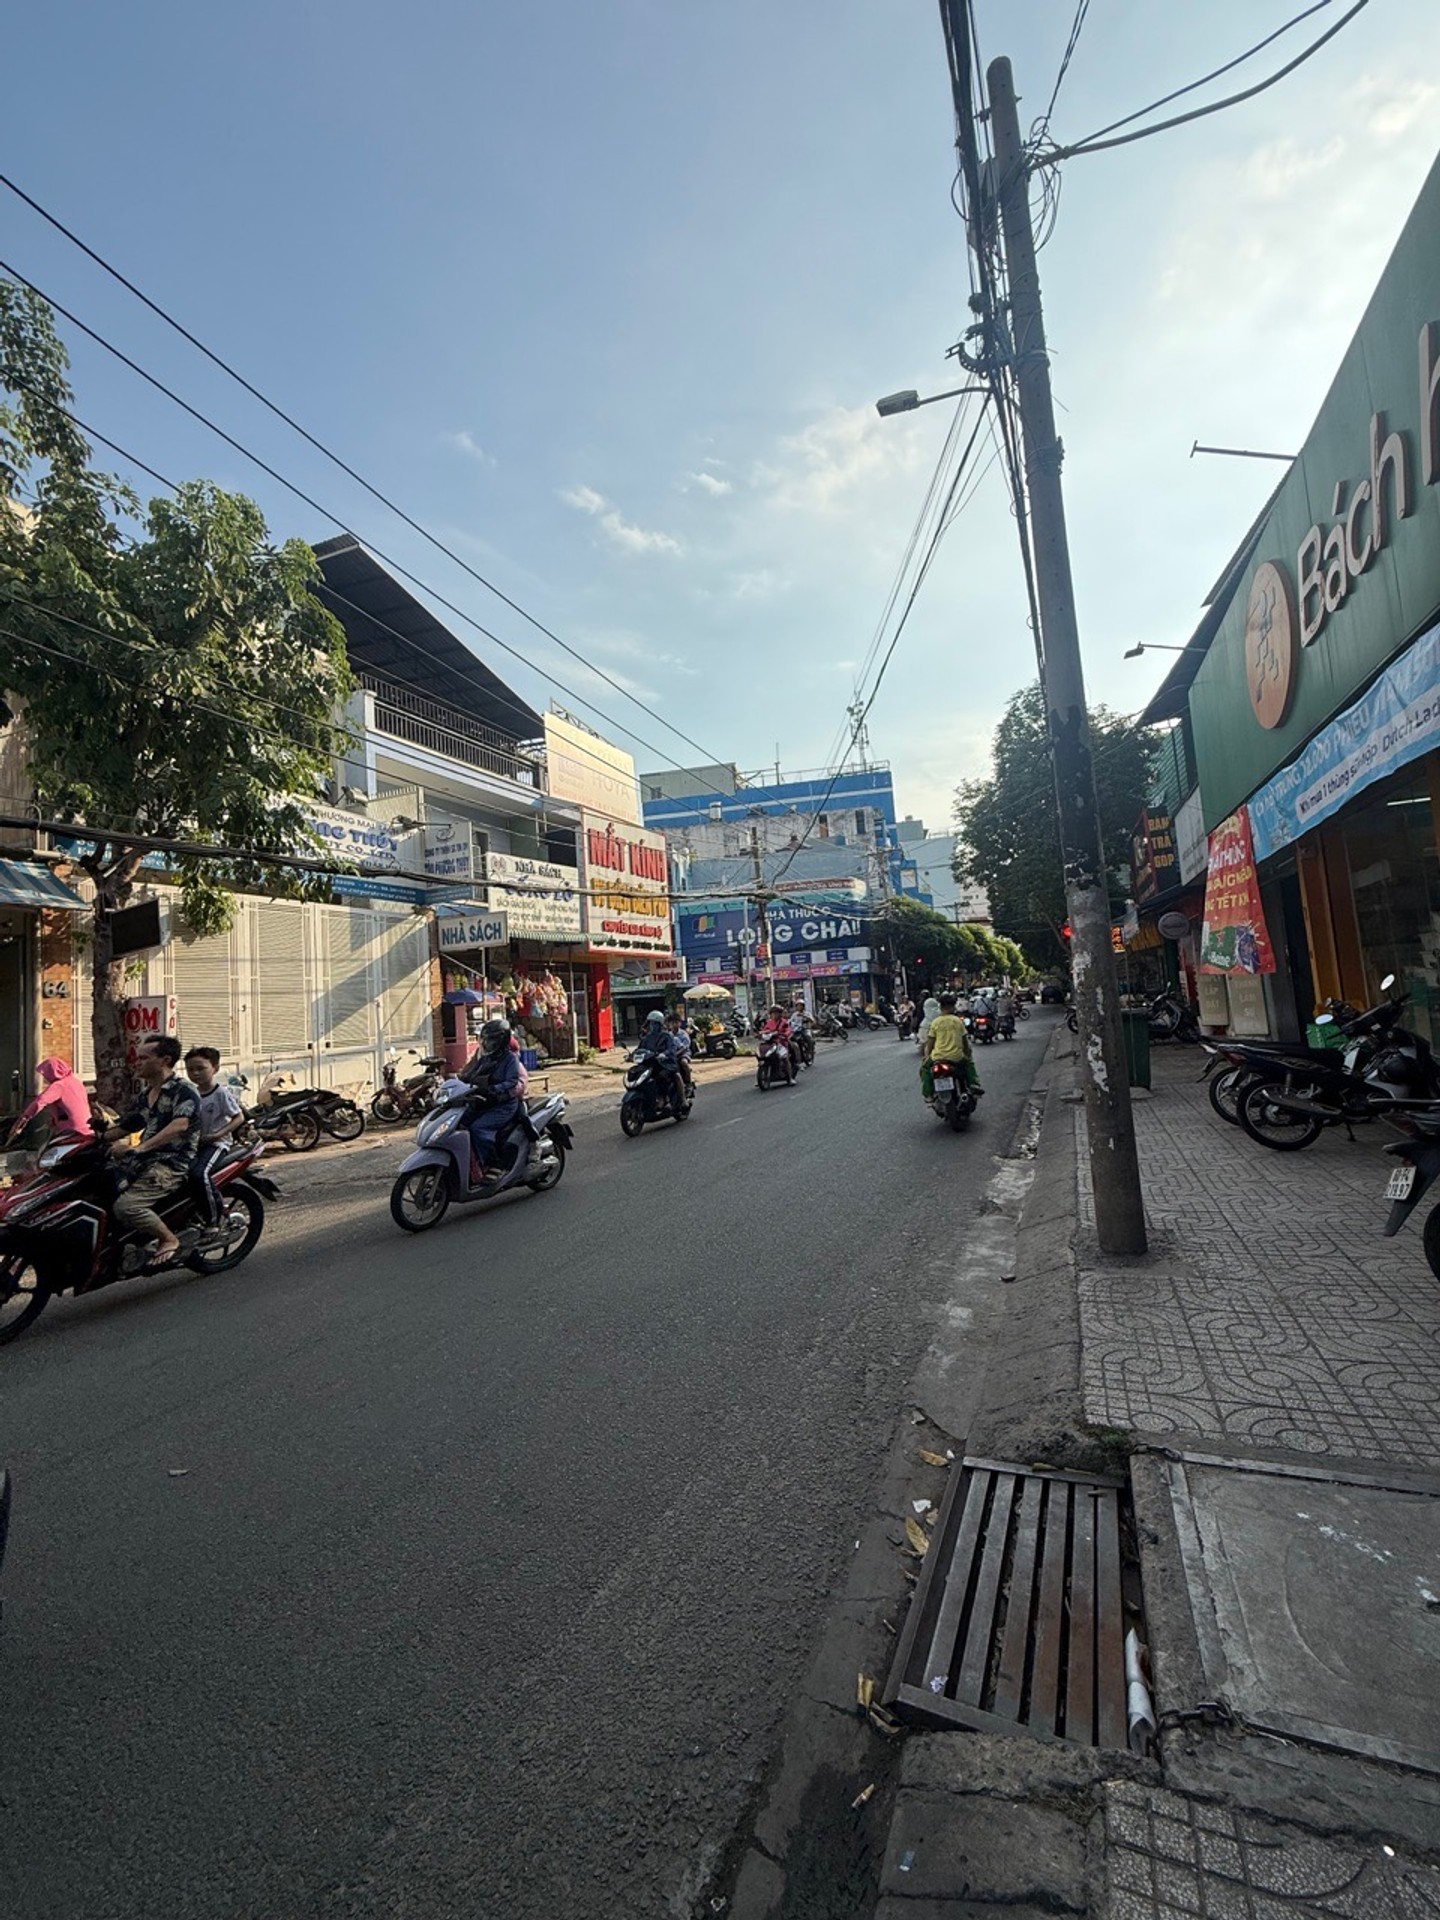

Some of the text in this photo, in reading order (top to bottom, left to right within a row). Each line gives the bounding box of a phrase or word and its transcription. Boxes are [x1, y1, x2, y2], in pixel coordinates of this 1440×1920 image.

[1297, 411, 1411, 648] Bách
[441, 923, 468, 946] NHÀ
[469, 918, 502, 943] SÁCH
[44, 981, 69, 998] 64
